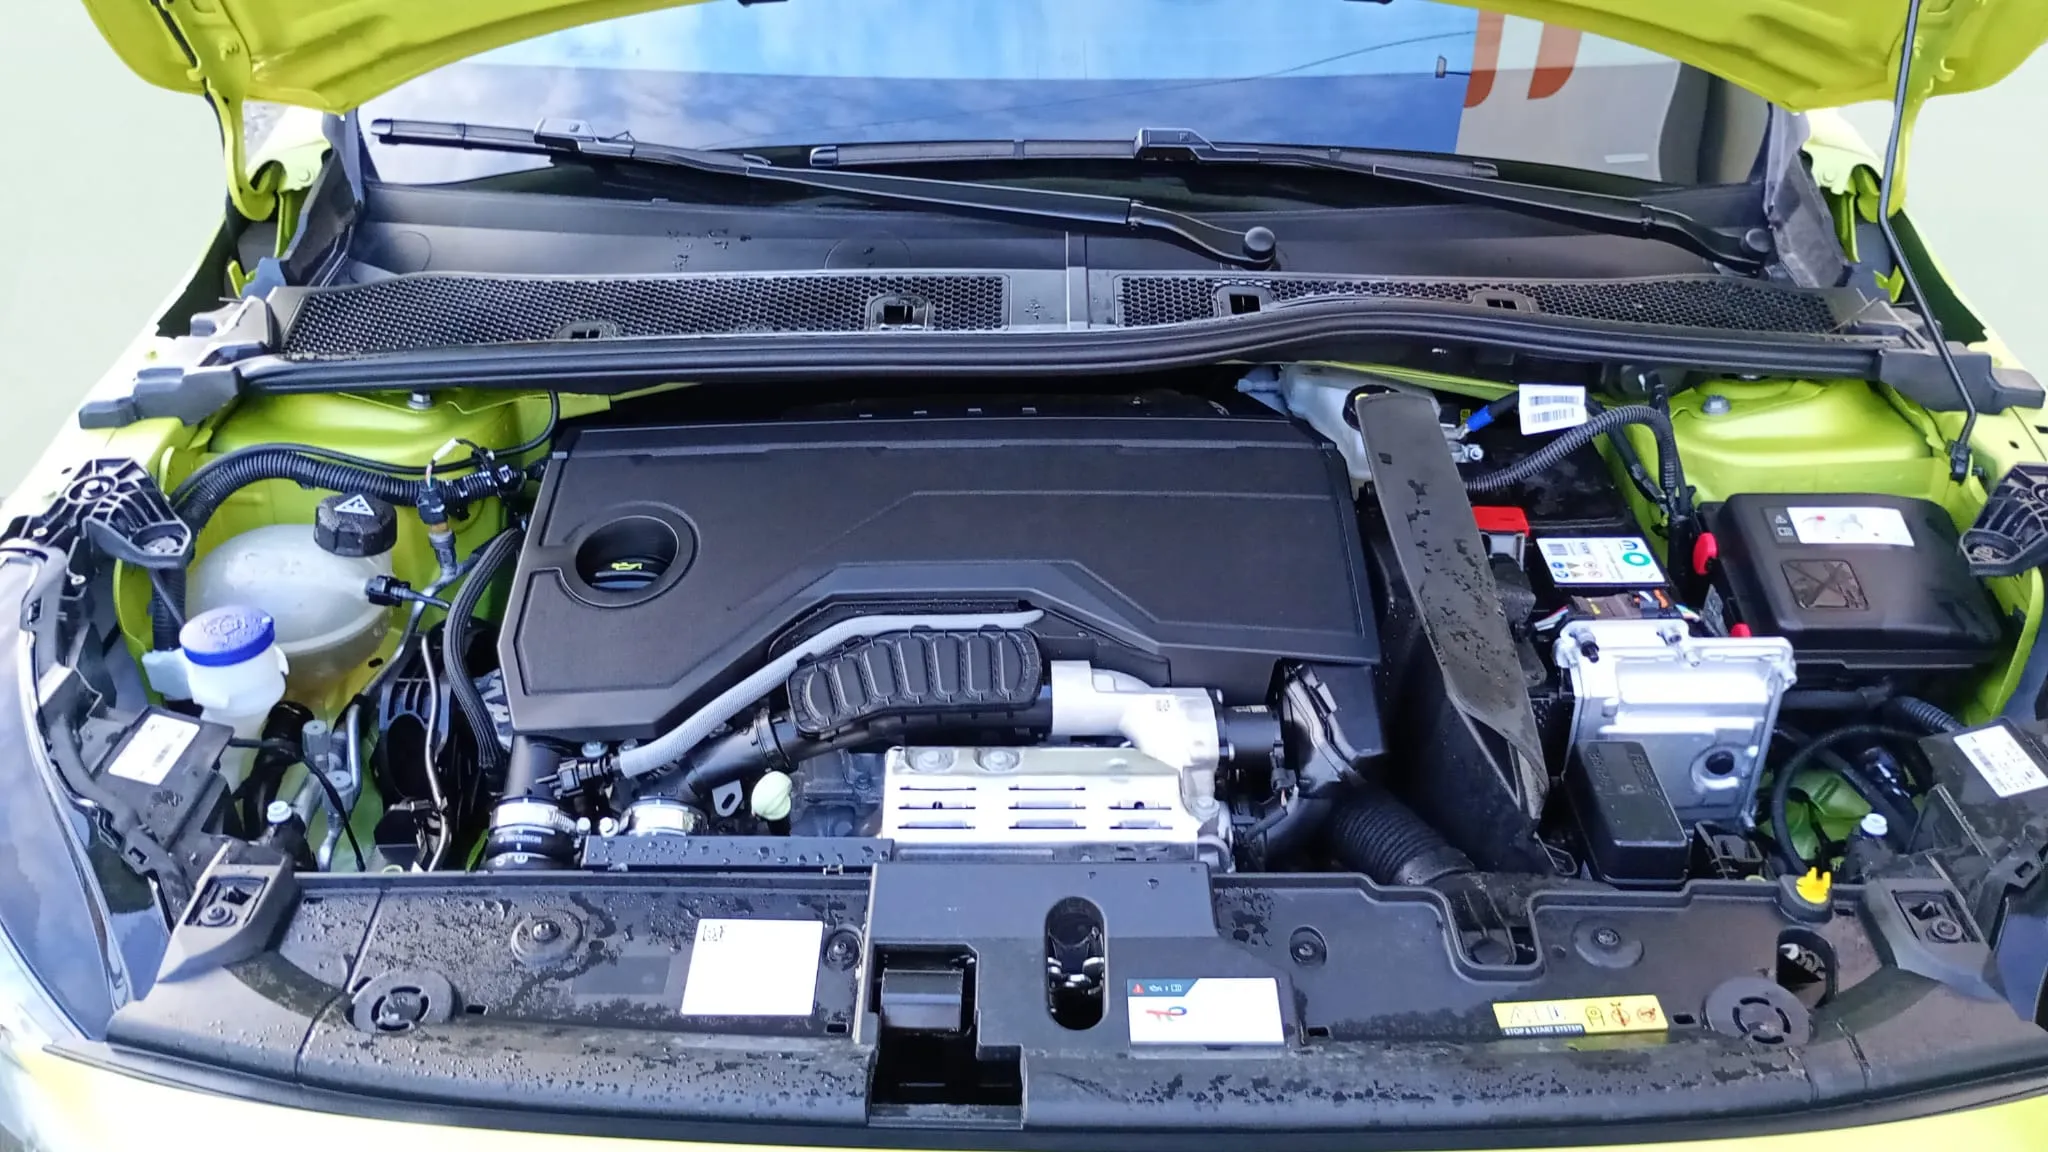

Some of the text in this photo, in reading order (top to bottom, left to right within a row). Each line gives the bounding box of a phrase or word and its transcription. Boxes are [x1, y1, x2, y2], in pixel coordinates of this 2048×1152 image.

[1505, 1027, 1524, 1036] STOP
[1532, 1026, 1554, 1034] START
[1555, 1024, 1584, 1034] SYSTEM
